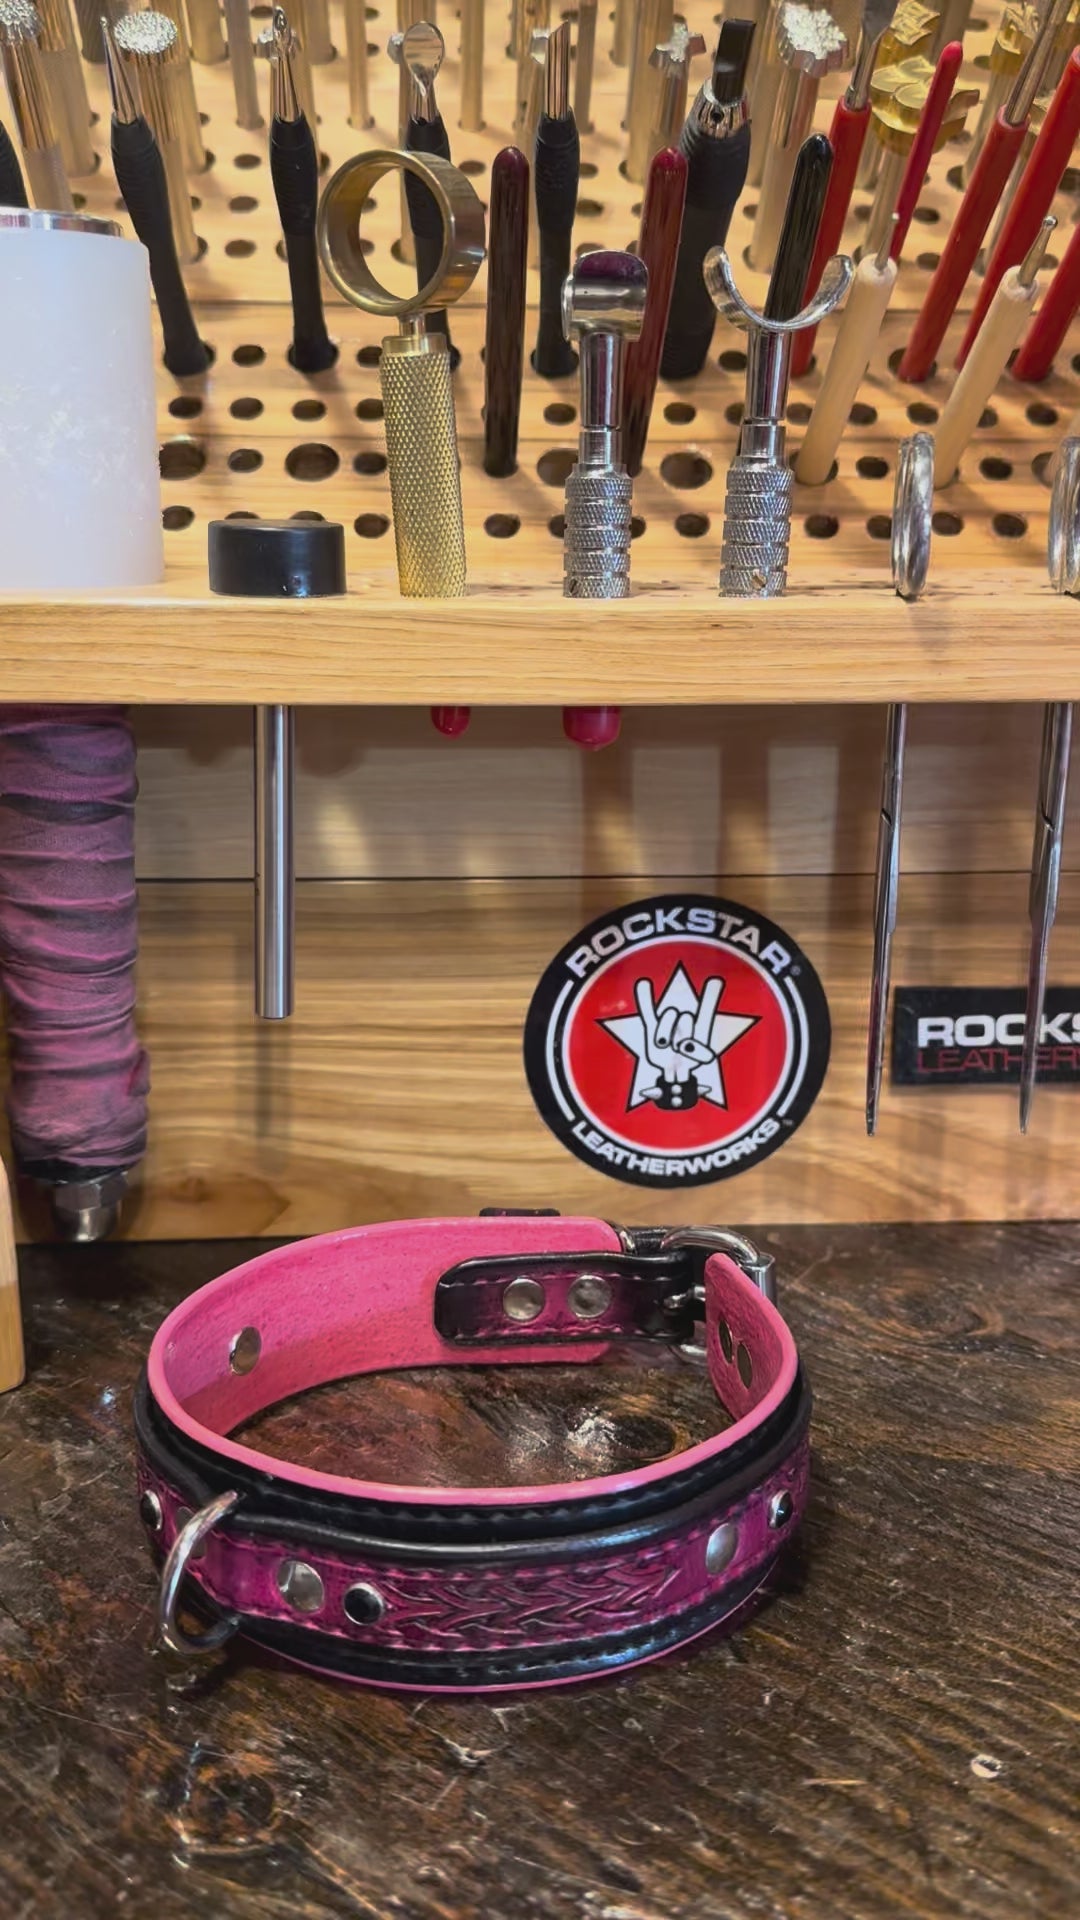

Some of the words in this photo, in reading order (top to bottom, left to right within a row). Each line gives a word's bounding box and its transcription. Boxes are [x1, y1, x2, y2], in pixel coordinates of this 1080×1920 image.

[565, 906, 792, 978] ROCKSTAR
[917, 1012, 1080, 1048] ROCK
[917, 1045, 1080, 1074] LEATHER
[571, 1117, 780, 1177] LEATHERWORKS
